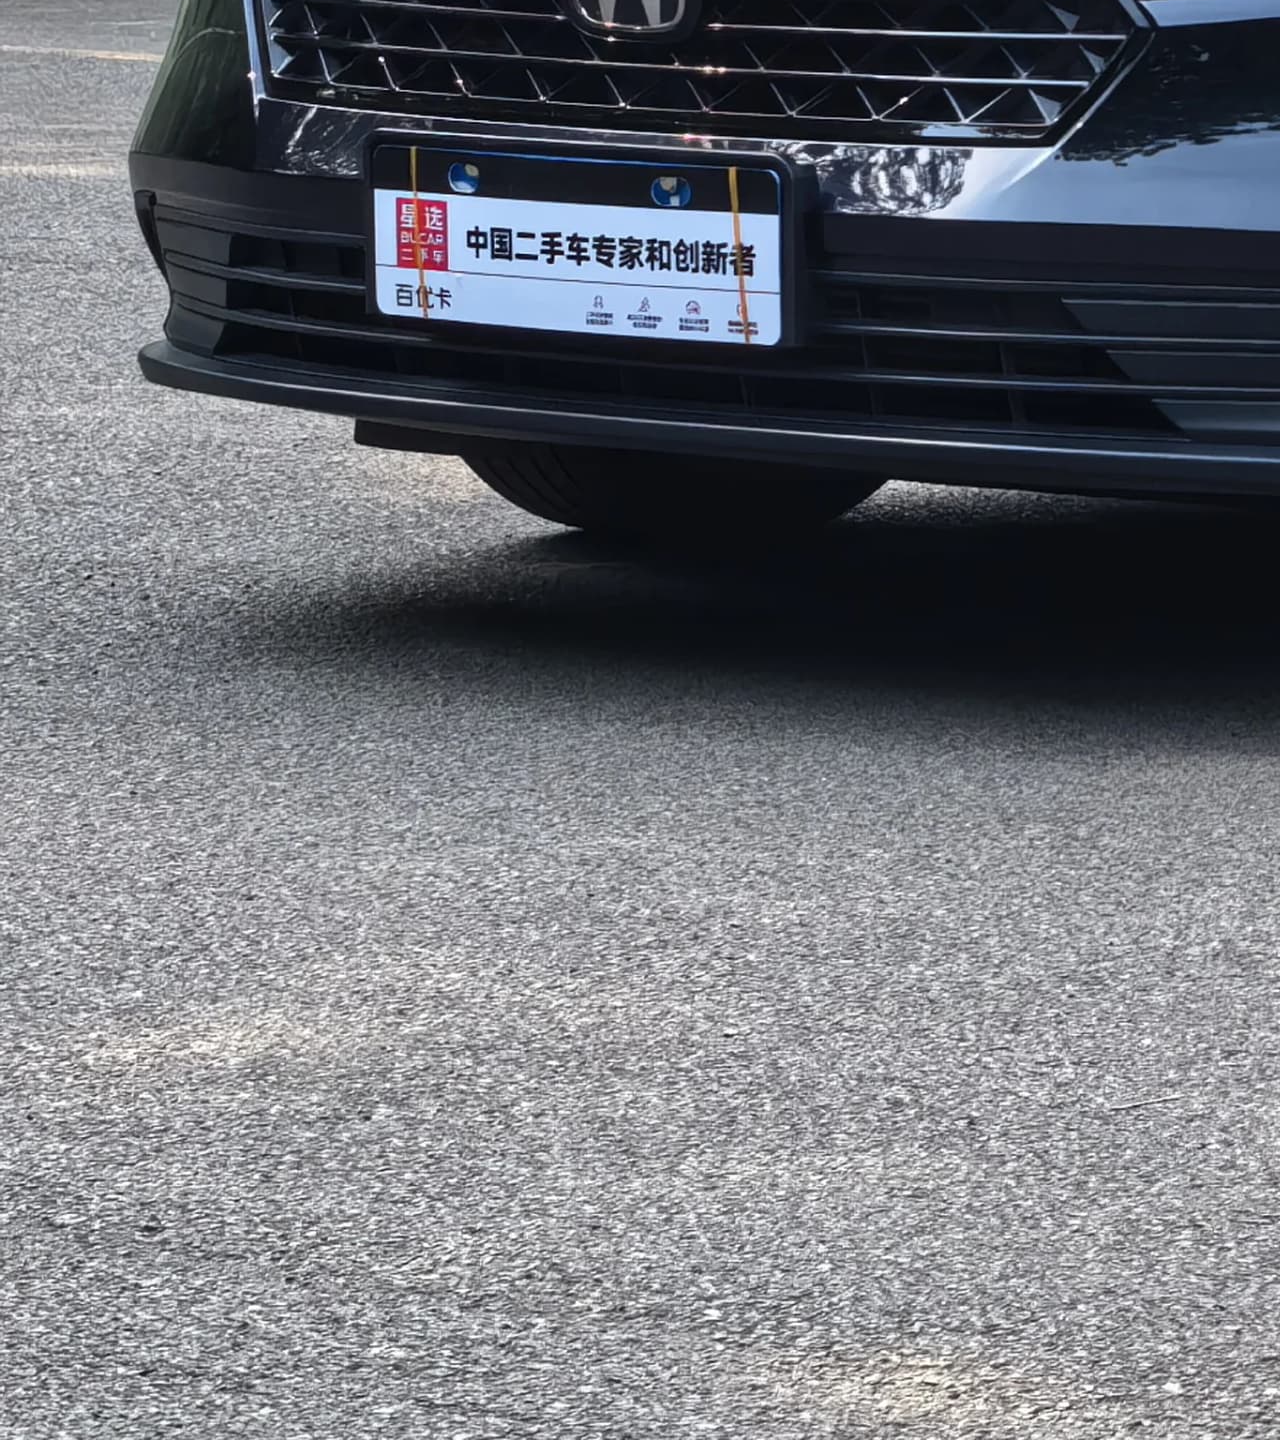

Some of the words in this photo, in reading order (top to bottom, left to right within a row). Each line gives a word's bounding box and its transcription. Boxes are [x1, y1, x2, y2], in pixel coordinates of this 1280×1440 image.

[399, 204, 444, 231] 星选
[466, 226, 757, 277] 中国二手车专家和创新者
[395, 283, 453, 310] 百优卡
